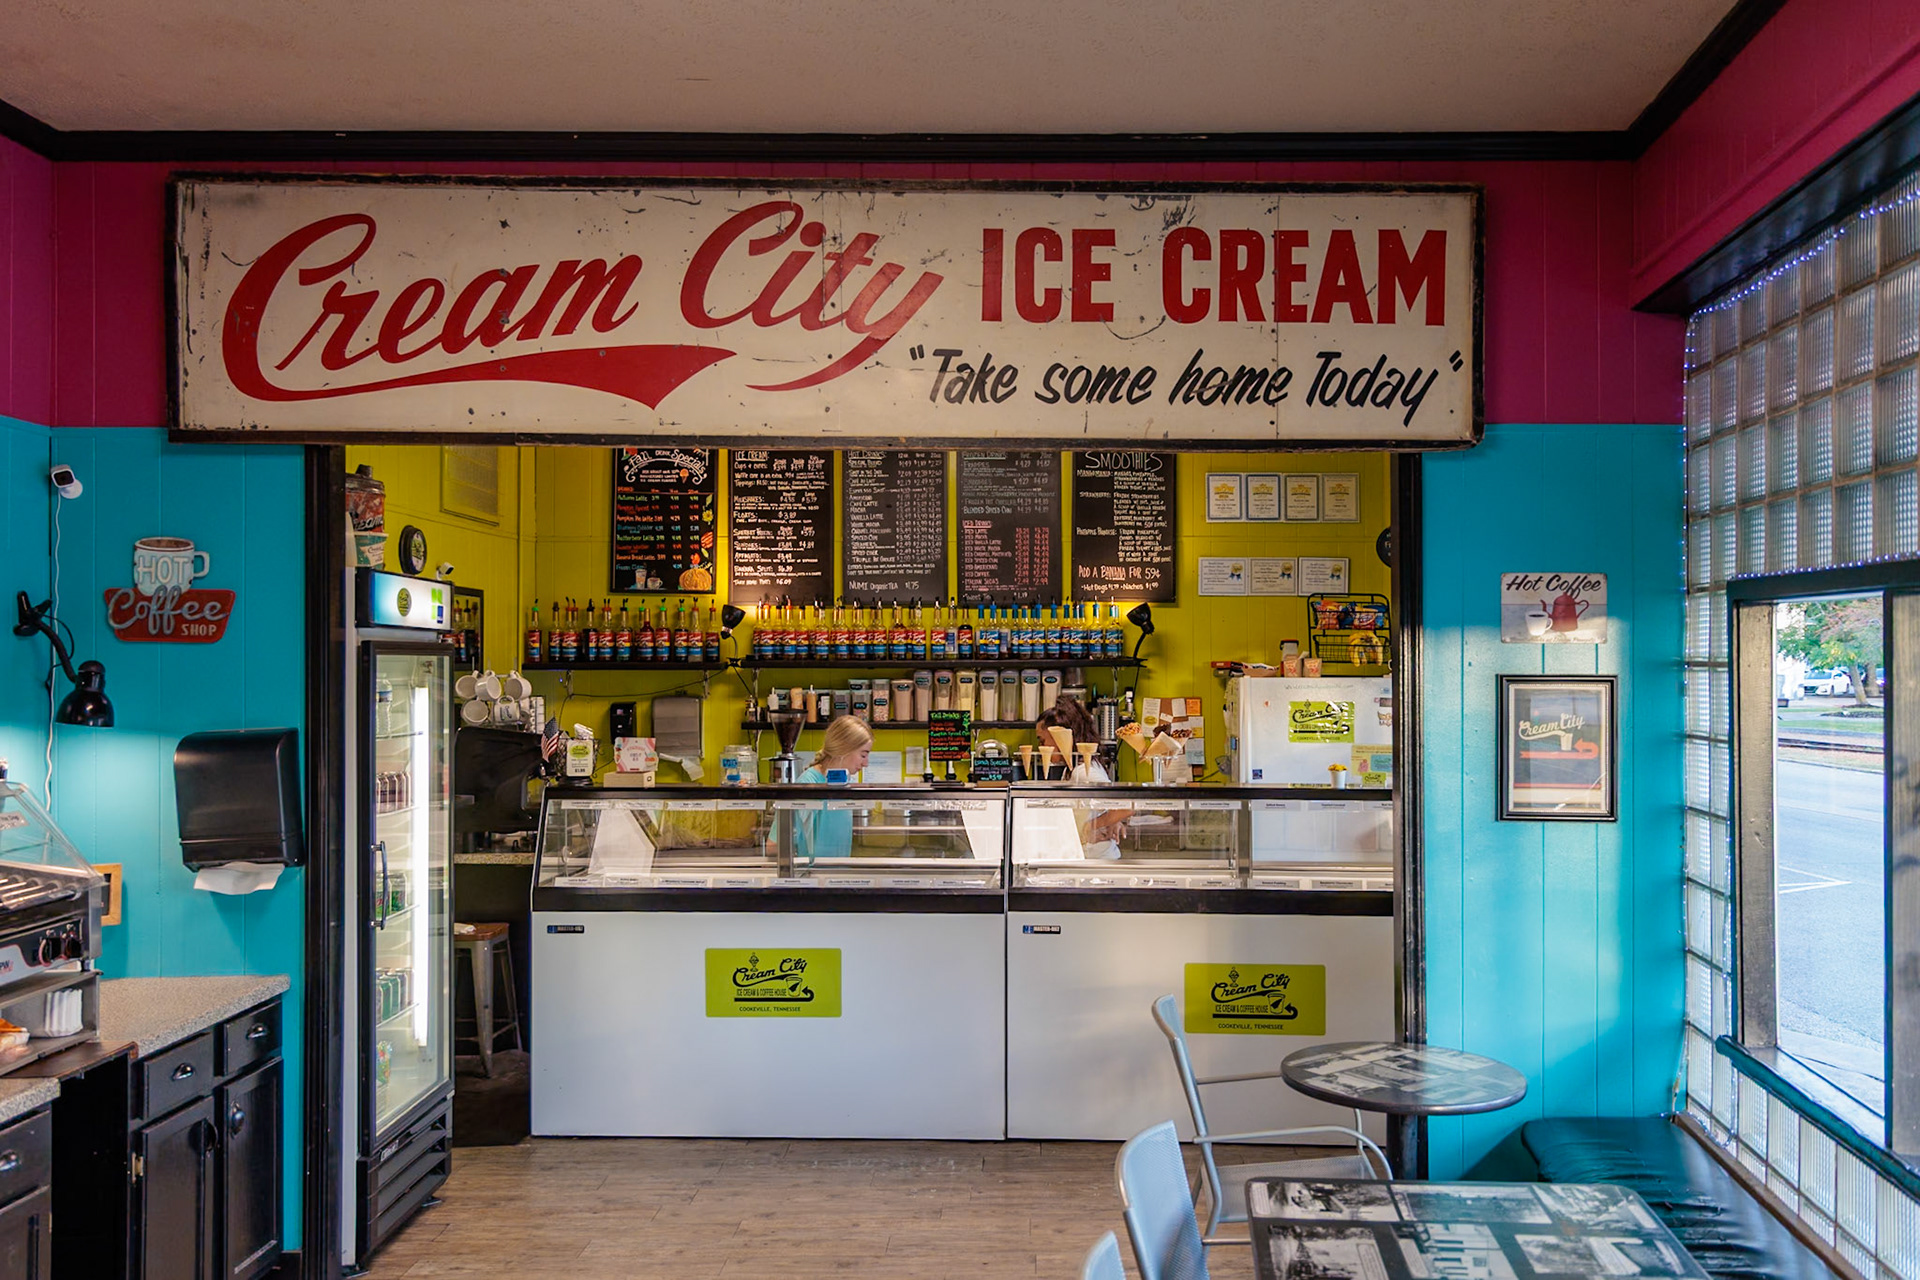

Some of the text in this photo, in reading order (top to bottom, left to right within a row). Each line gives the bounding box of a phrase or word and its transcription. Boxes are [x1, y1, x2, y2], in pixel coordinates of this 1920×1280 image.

[981, 228, 1447, 326] ICE CREAM
[222, 201, 944, 402] Cream City
[909, 345, 1464, 428] "Take some home Today"
[629, 451, 652, 467] Fall
[671, 449, 706, 474] Specials
[1085, 451, 1163, 472] SMOOTHIES
[137, 556, 189, 584] HOT
[1078, 565, 1091, 578] ADD
[1092, 566, 1098, 578] A
[1101, 565, 1126, 579] BANANA
[1128, 566, 1142, 578] FOR
[1506, 574, 1602, 600] Hot Coffee
[108, 585, 229, 634] Coffee
[181, 624, 217, 635] SHOP
[732, 958, 808, 988] Cream City
[743, 988, 756, 997] CREAM
[760, 988, 774, 997] COFFEE
[774, 988, 787, 997] HOUSE
[1210, 973, 1291, 1004] Cream City
[1222, 1004, 1236, 1013] CREAM
[1240, 1004, 1255, 1013] COFFEE
[1256, 1004, 1269, 1013] HOUSE
